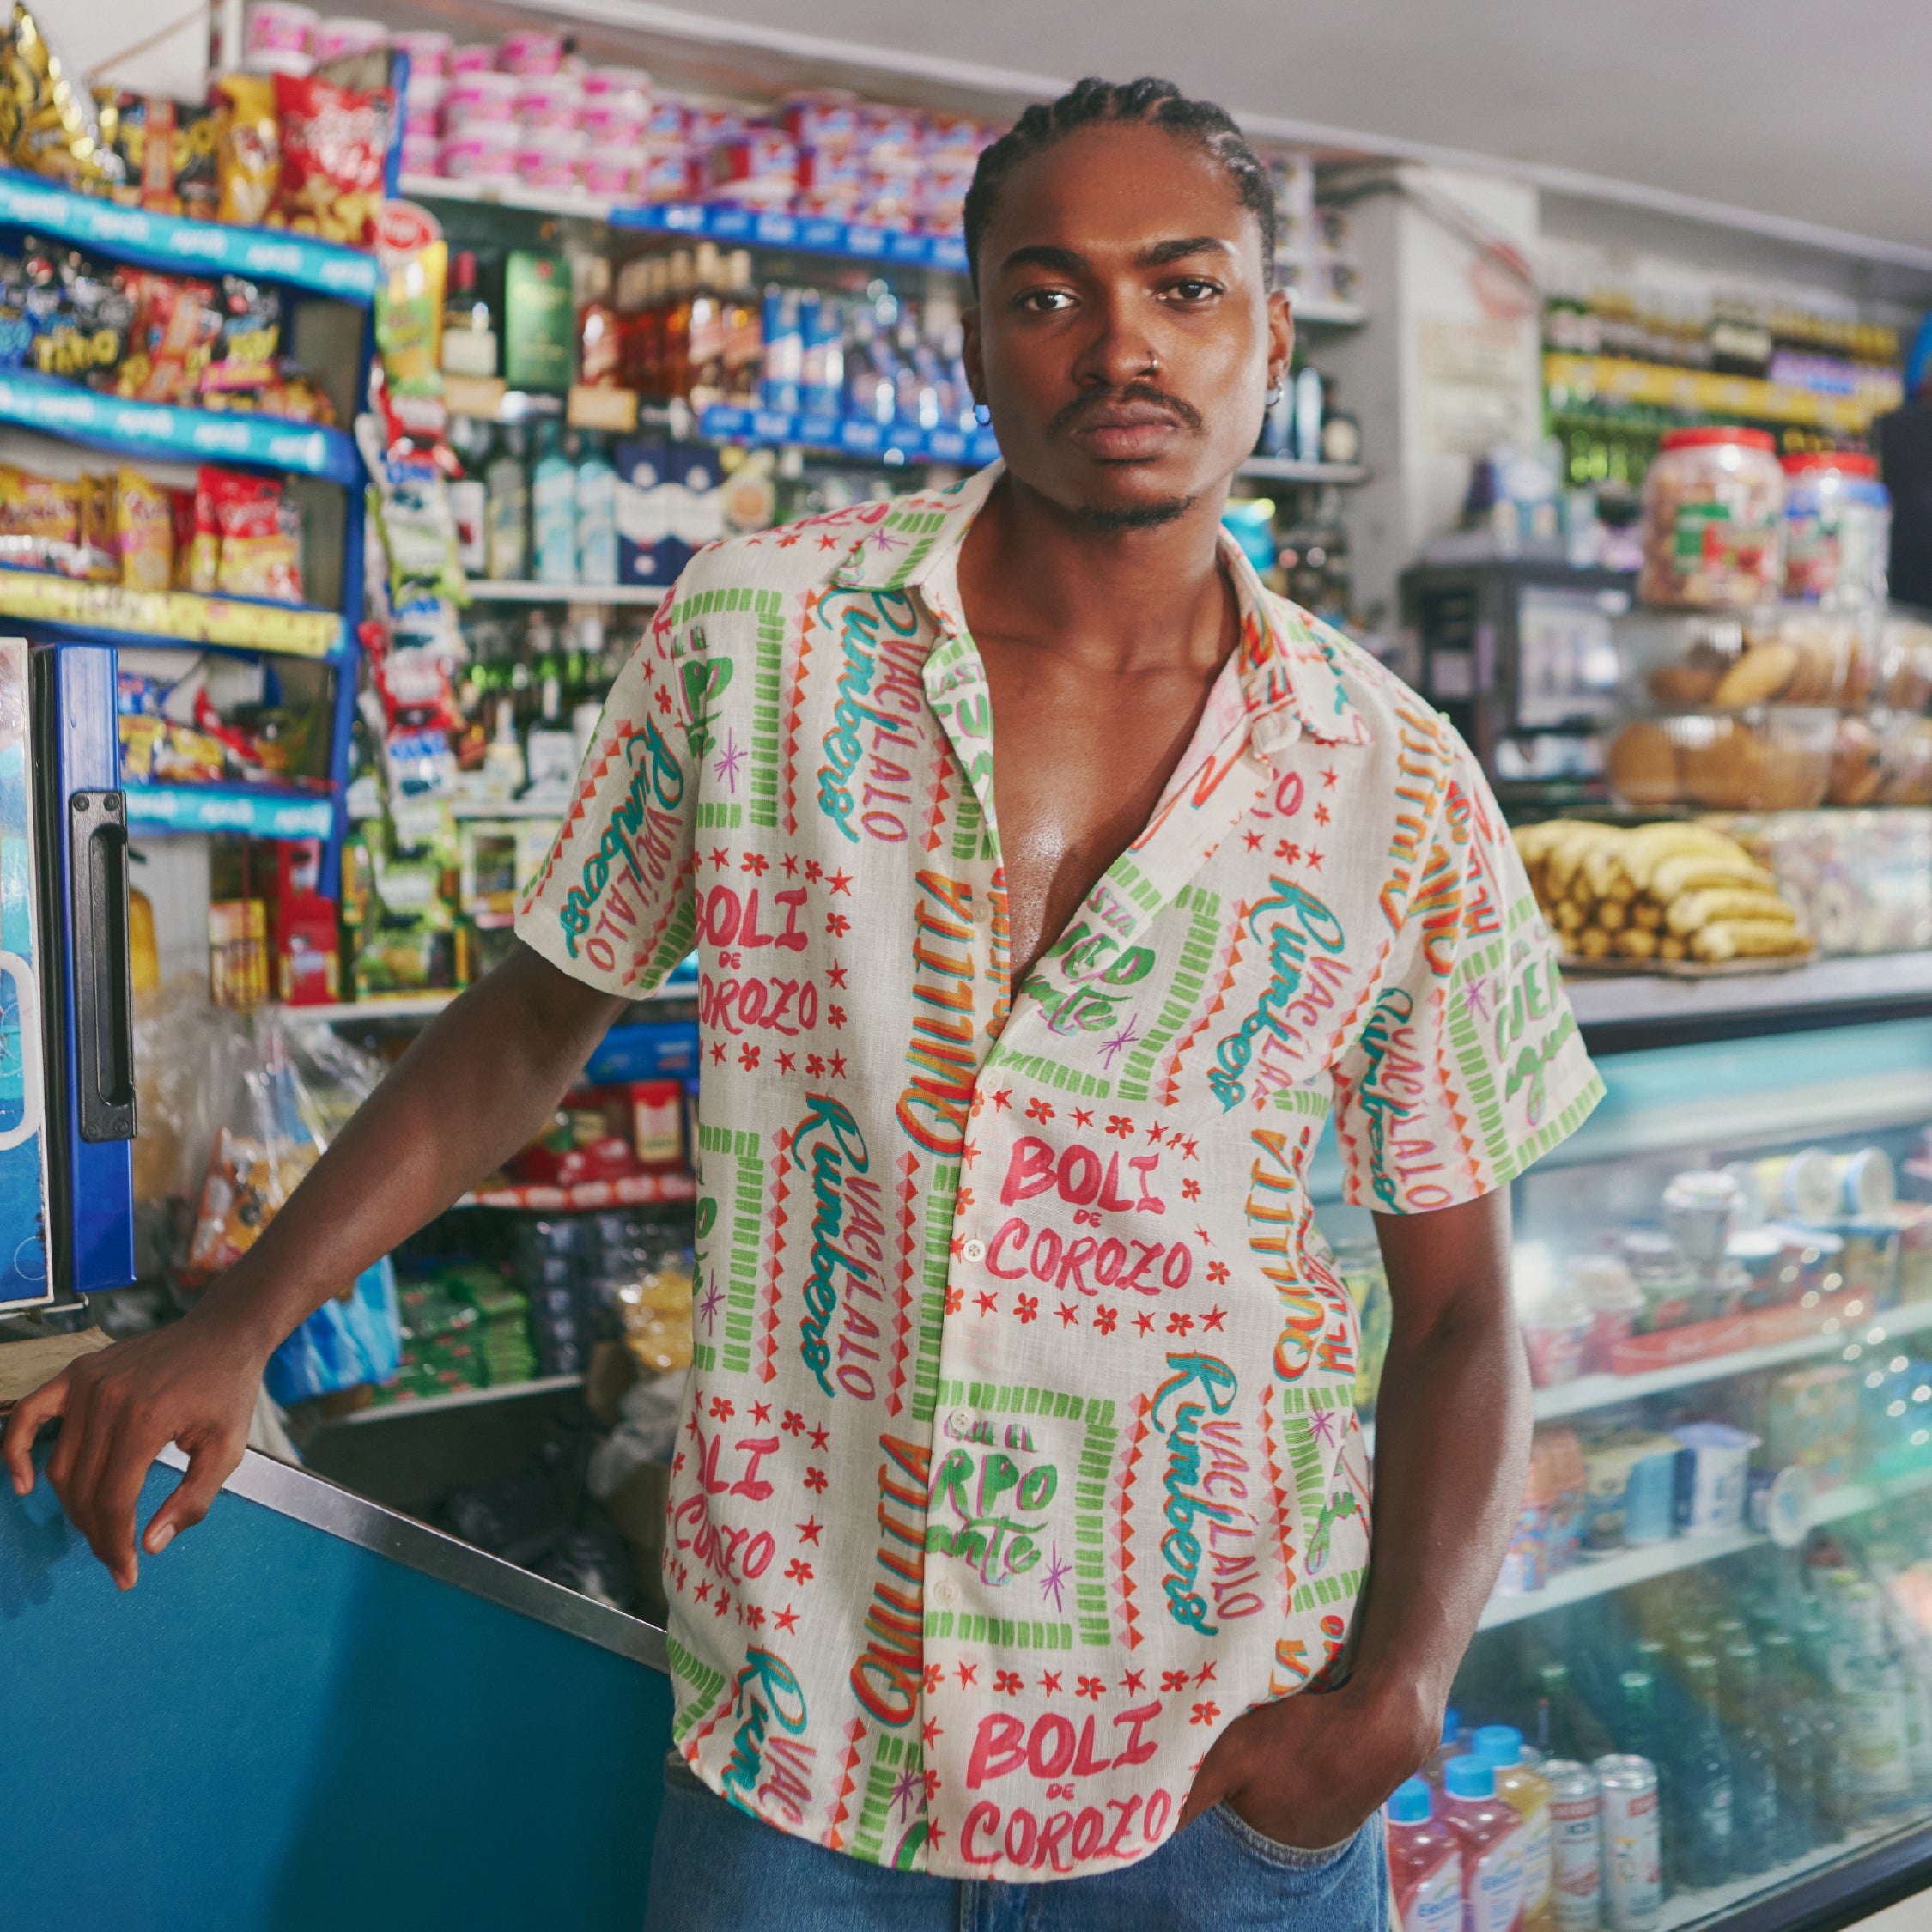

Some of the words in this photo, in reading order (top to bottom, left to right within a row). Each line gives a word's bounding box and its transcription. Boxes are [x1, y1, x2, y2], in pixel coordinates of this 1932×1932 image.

[695, 884, 809, 952] OLI
[718, 951, 743, 970] DE
[698, 977, 818, 1036] OROZO
[896, 868, 977, 1157] QUILLITA
[1000, 1136, 1166, 1216] BOLI
[1072, 1208, 1103, 1228] DE
[985, 1216, 1193, 1297] COROZO
[967, 1700, 1163, 1790] BOLI
[1045, 1783, 1075, 1800] DE
[961, 1789, 1172, 1873] COROZO
